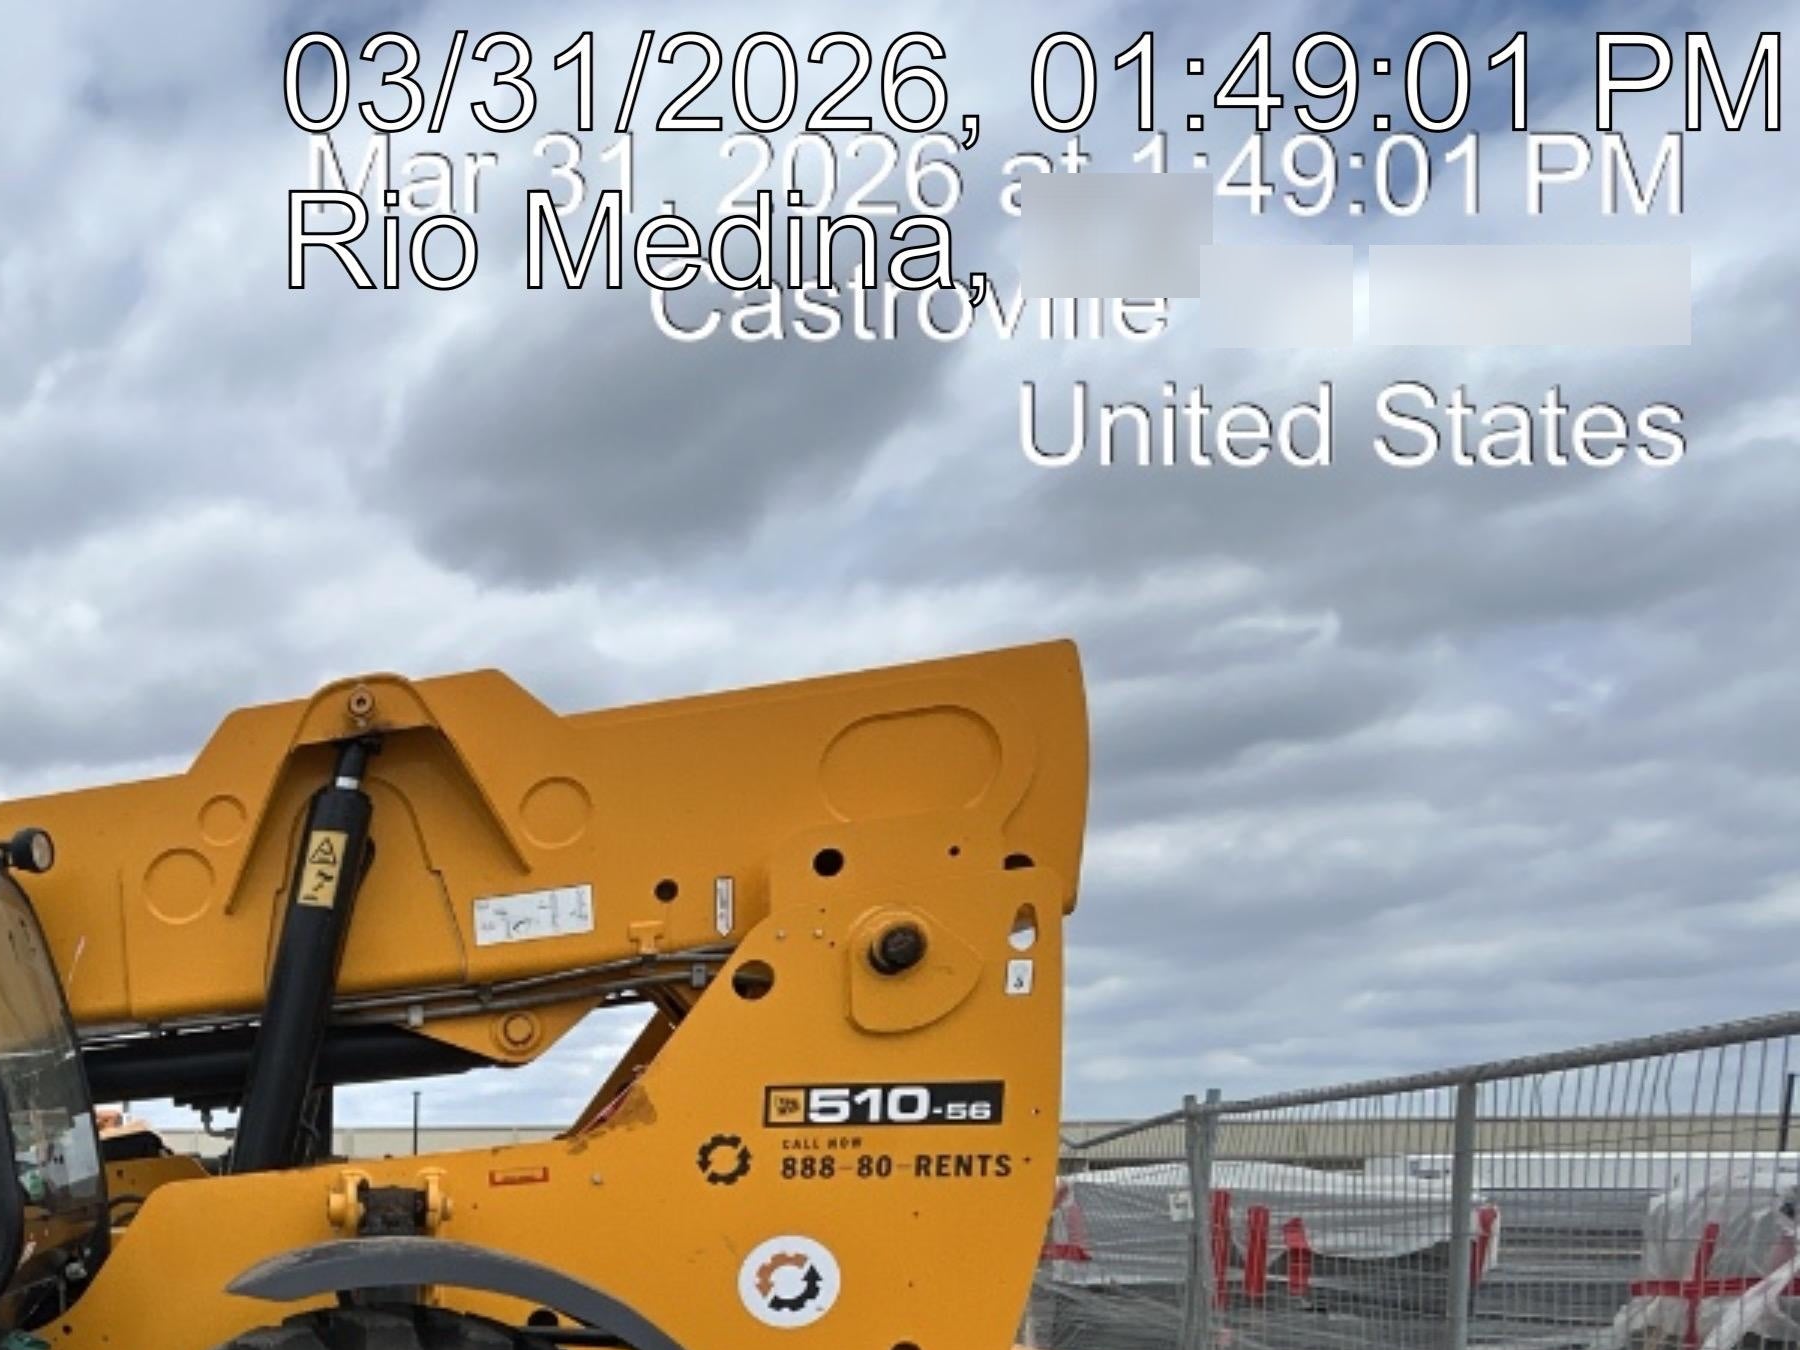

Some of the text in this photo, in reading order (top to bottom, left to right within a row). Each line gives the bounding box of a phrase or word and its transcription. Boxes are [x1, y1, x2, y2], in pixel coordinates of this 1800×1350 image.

[807, 1086, 992, 1123] 510-56
[781, 1136, 863, 1150] CALL NOW
